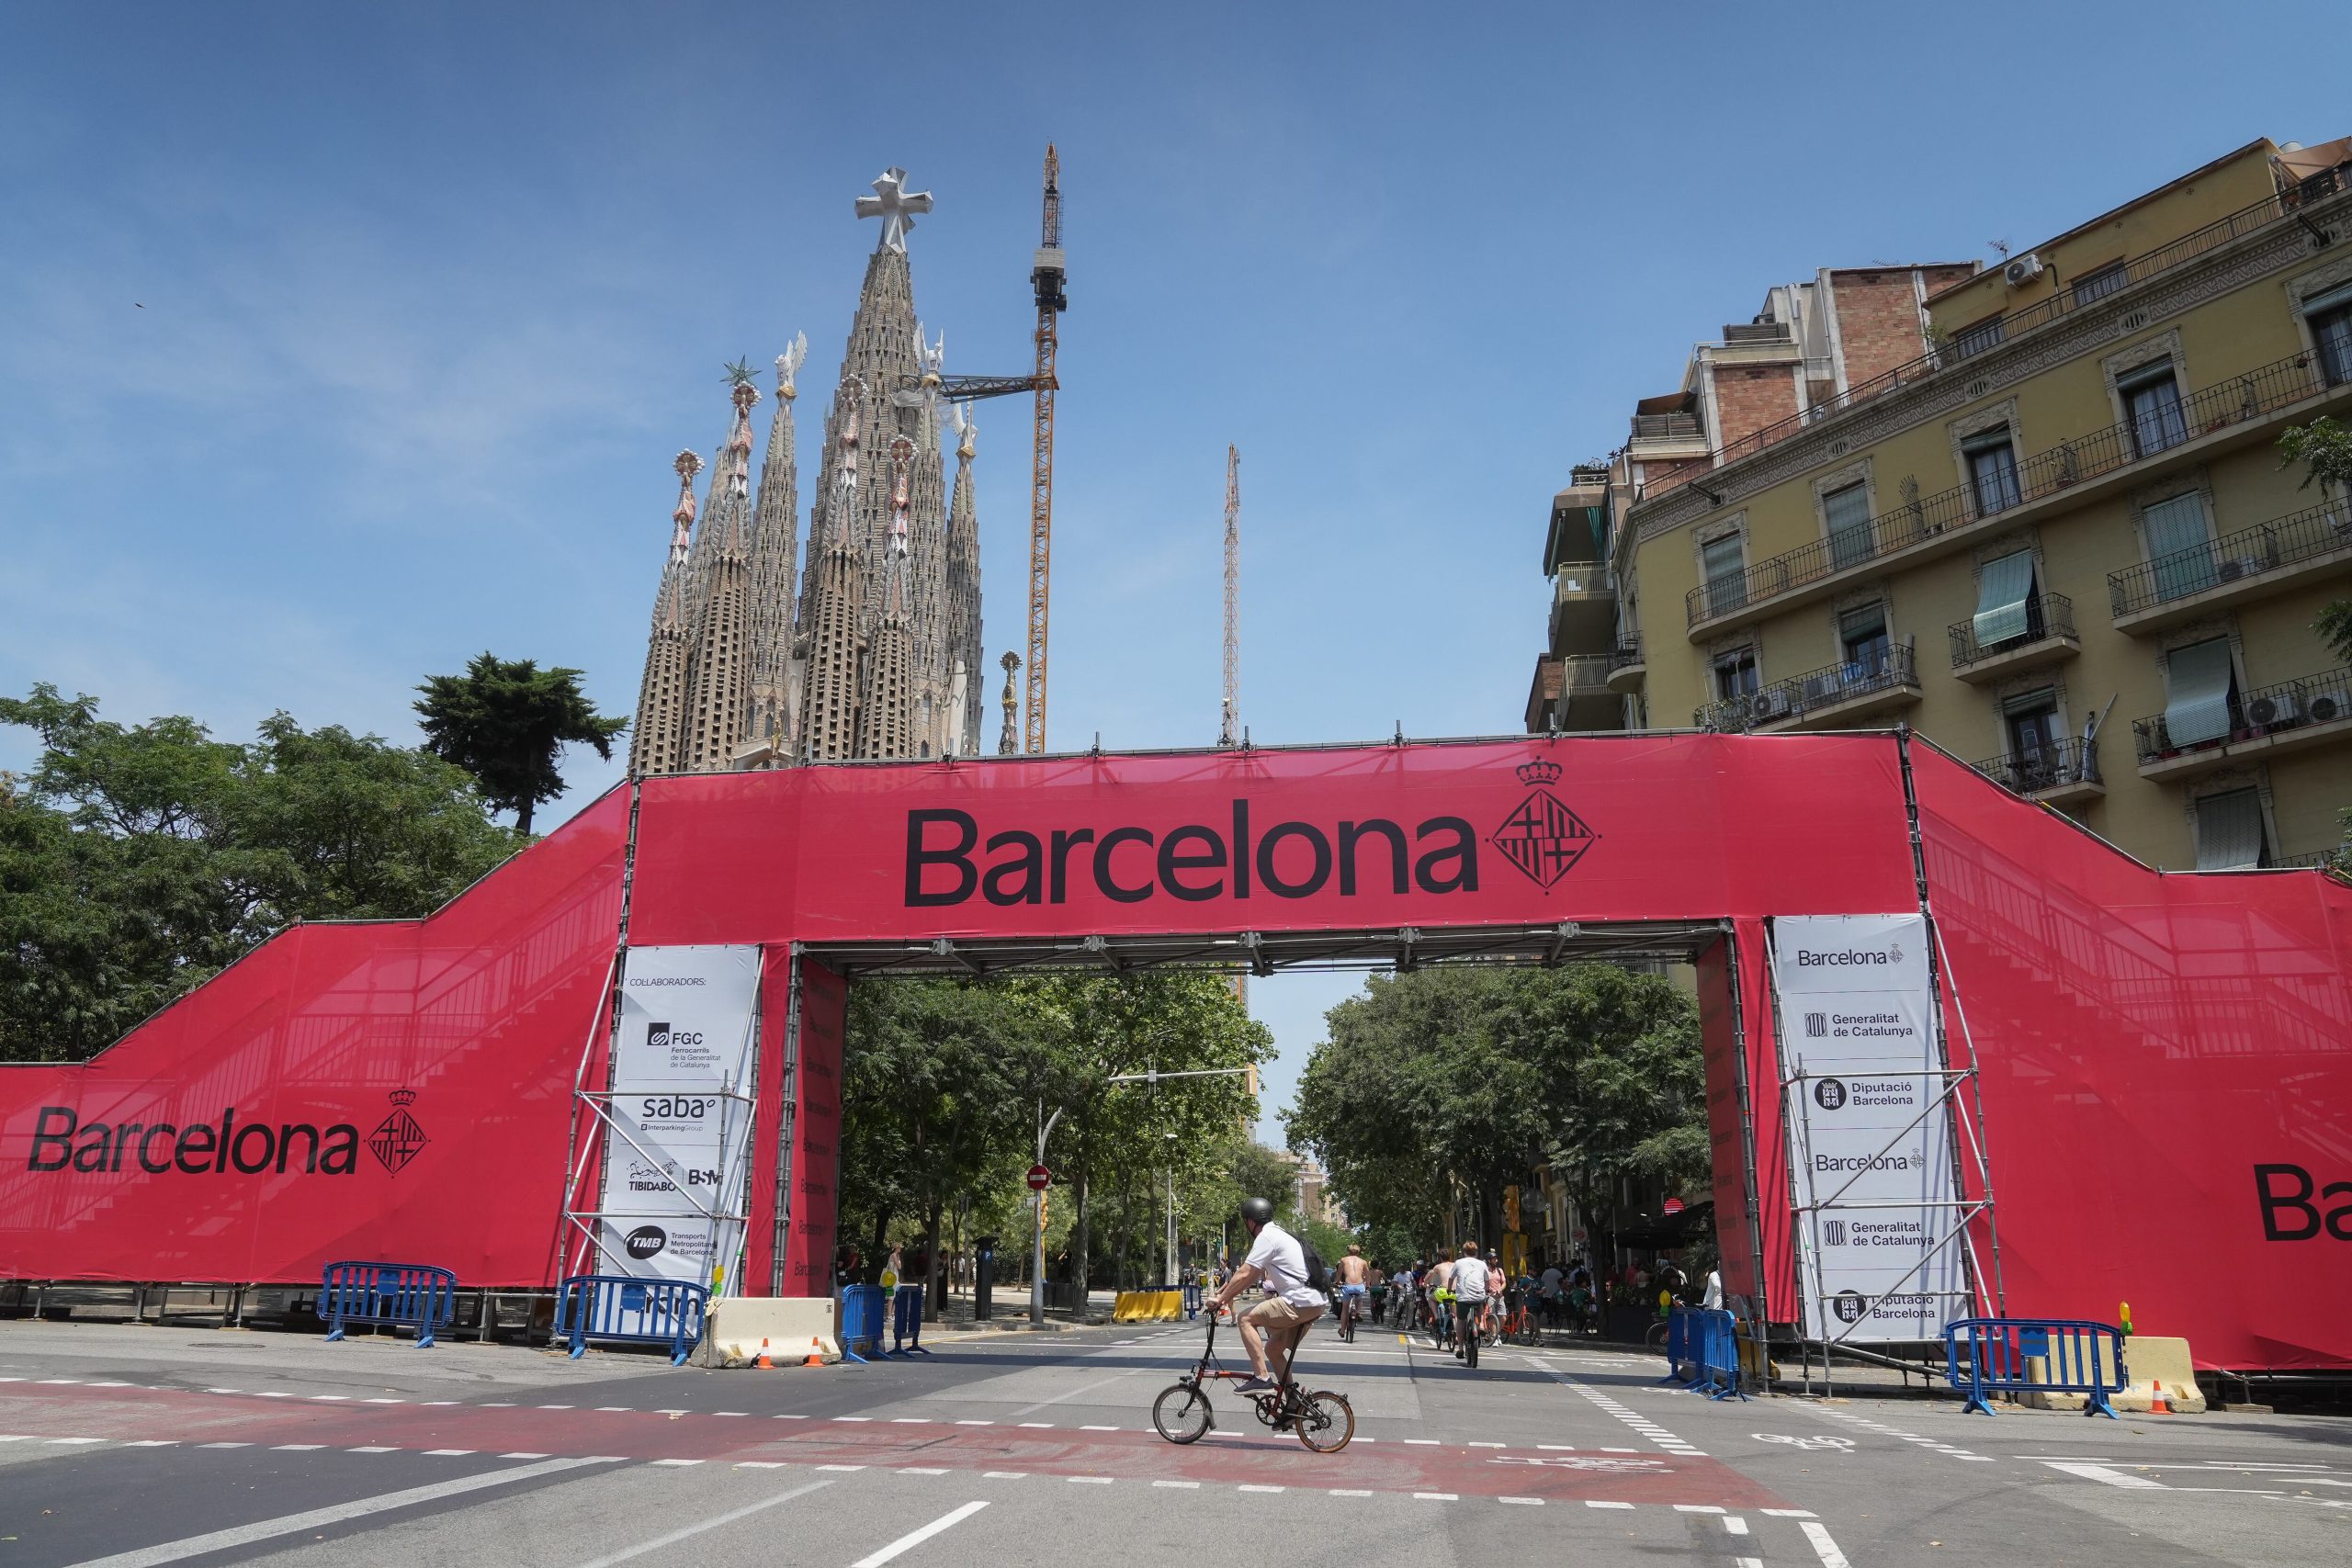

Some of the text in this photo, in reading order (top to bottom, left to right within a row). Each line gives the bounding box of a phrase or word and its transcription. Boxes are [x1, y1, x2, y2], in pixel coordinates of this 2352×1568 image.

[904, 799, 1480, 908] Barcelona
[1798, 949, 1887, 966] Barcelona
[1832, 1013, 1900, 1024] Generalitat
[1833, 1026, 1913, 1038] de Catalunya
[672, 1032, 703, 1045] FGC
[1851, 1082, 1912, 1094] Diputació
[1853, 1096, 1914, 1106] Barcelona
[28, 1106, 359, 1175] Barcelona
[1815, 1153, 1908, 1171] Barcelona
[628, 1181, 676, 1191] TIBIDABO
[1851, 1222, 1921, 1233] Generalitat
[633, 1237, 662, 1248] TMB
[1852, 1235, 1935, 1247] de Catalunya
[1872, 1308, 1935, 1319] Barcelona
